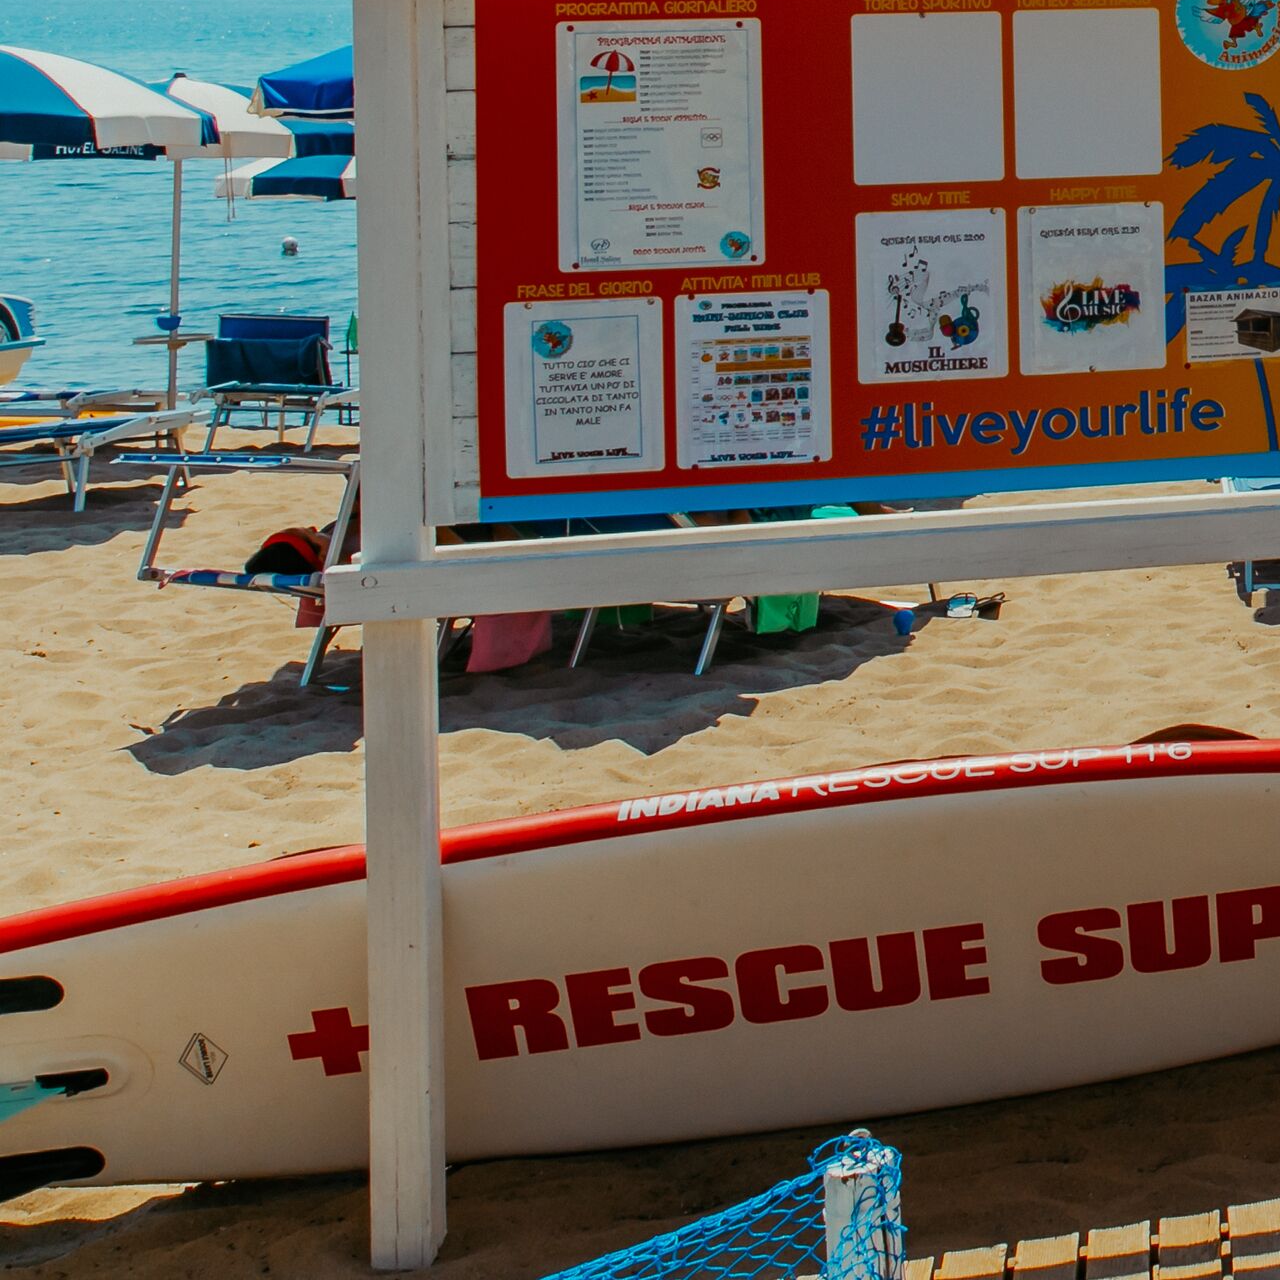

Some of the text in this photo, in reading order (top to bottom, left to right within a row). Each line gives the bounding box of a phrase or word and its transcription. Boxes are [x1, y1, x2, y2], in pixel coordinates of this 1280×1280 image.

[555, 0, 758, 16] PROGRAMMA GIORNALIERO
[597, 35, 661, 47] PROGRAMMA
[891, 191, 971, 207] SHOW TIME
[1050, 185, 1137, 201] HAPPY TIME
[1039, 227, 1076, 239] QUESTA
[1076, 226, 1099, 238] SERA
[1101, 226, 1120, 236] ORE
[880, 234, 917, 247] QUESTA
[917, 233, 941, 245] SERA
[942, 233, 962, 244] ORE
[751, 274, 782, 289] MINI
[785, 272, 821, 287] CLUB
[517, 280, 653, 299] FRASE DEL GIORNO
[1081, 288, 1127, 305] LIVE
[1190, 294, 1223, 303] BAZAR
[1081, 303, 1127, 317] MUSIC
[927, 346, 946, 359] IL
[543, 361, 575, 370] TUTTO
[598, 358, 617, 367] CHE
[619, 357, 631, 366] CI
[884, 356, 988, 375] MUSICHIERE
[548, 373, 578, 382] SERVE
[590, 370, 624, 379] AMORE
[539, 384, 589, 394] TUTTAVIA
[591, 383, 605, 391] UN
[623, 380, 635, 389] DI
[592, 393, 603, 402] DI
[606, 392, 639, 401] TANTO
[544, 403, 632, 417] IN TANTO NON FA
[575, 416, 601, 426] MALE
[859, 387, 1225, 455] #liveyourlife
[617, 780, 780, 822] INDIANA
[790, 756, 997, 799] RESCUE
[1008, 748, 1101, 774] SUP
[465, 922, 991, 1062] RESCUE
